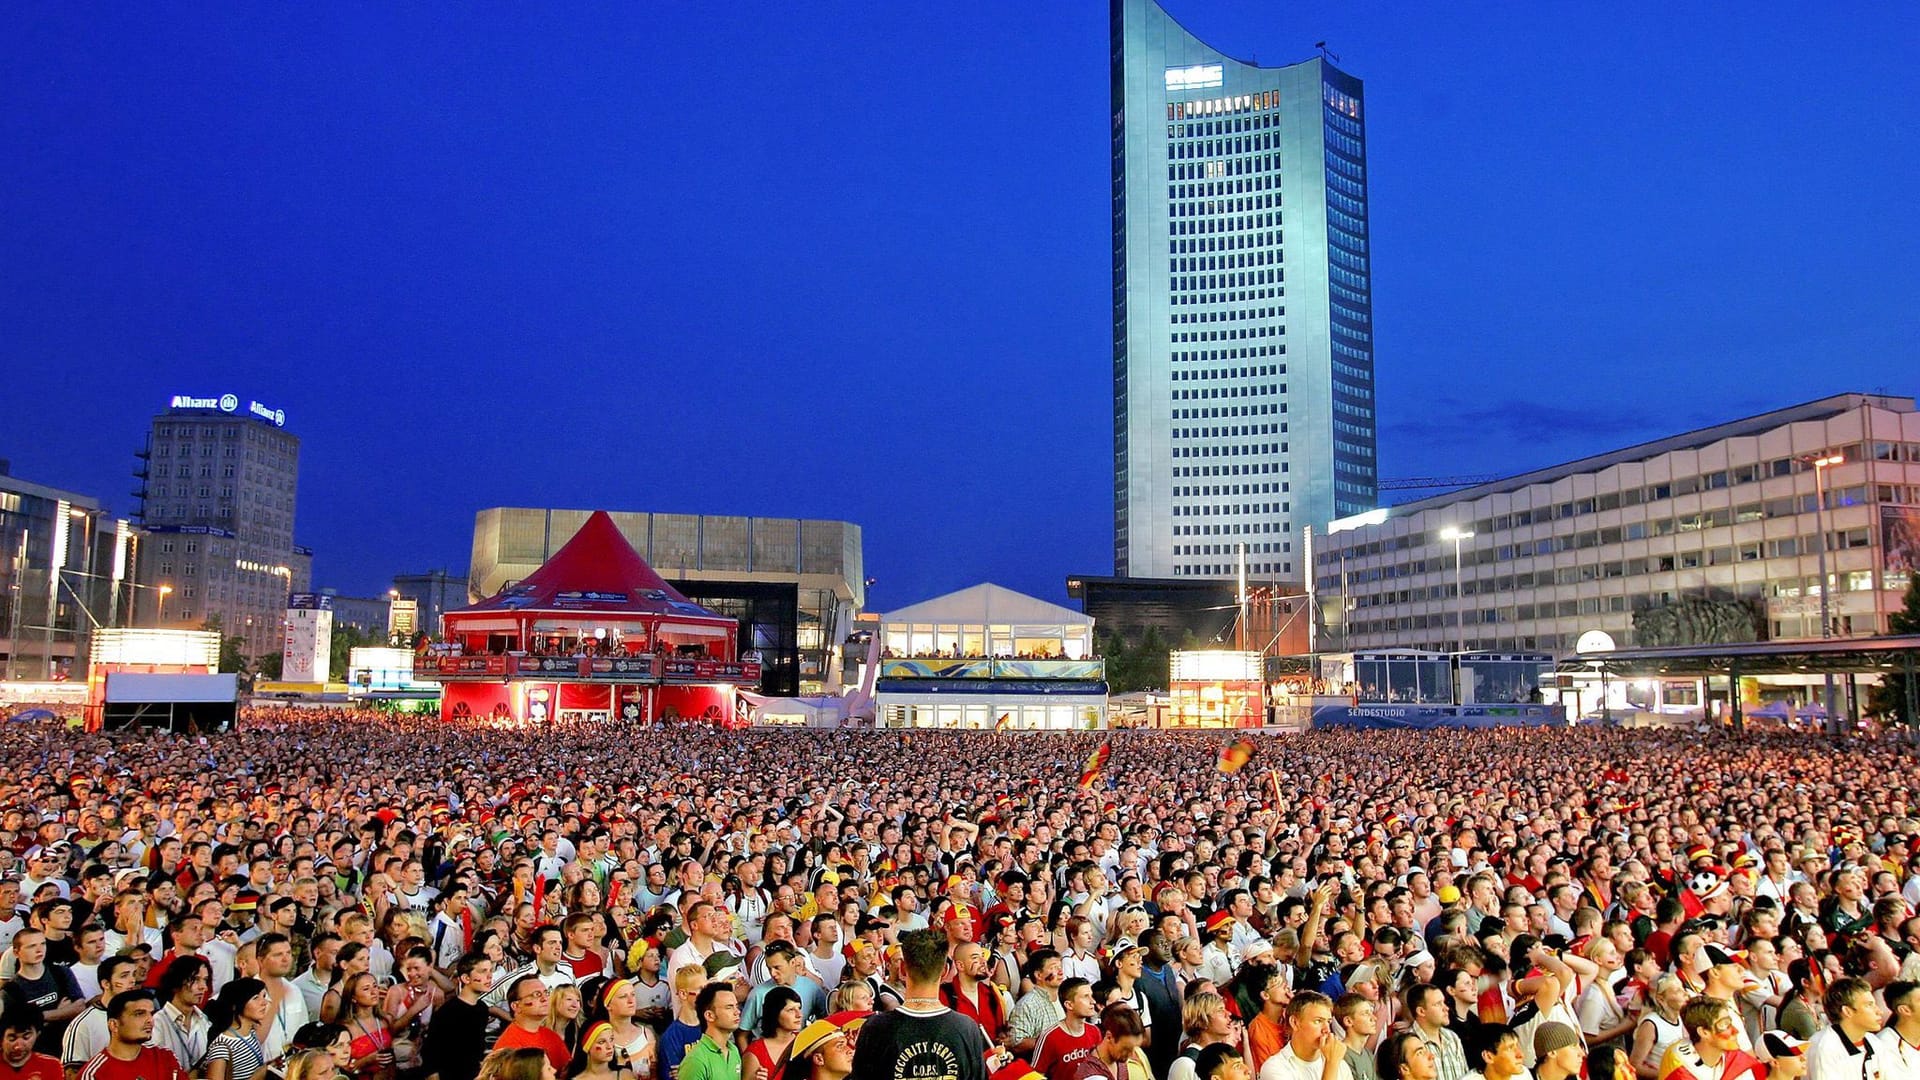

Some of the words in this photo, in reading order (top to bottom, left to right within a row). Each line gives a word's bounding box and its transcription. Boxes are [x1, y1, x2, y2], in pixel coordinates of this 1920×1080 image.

[171, 395, 218, 408] Allianz
[250, 400, 275, 420] Allianz
[1347, 708, 1405, 717] SENDESTUDIO
[894, 1041, 928, 1079] SECURITY
[931, 1042, 958, 1075] SERVICE
[912, 1064, 939, 1077] C.O.P.S.
